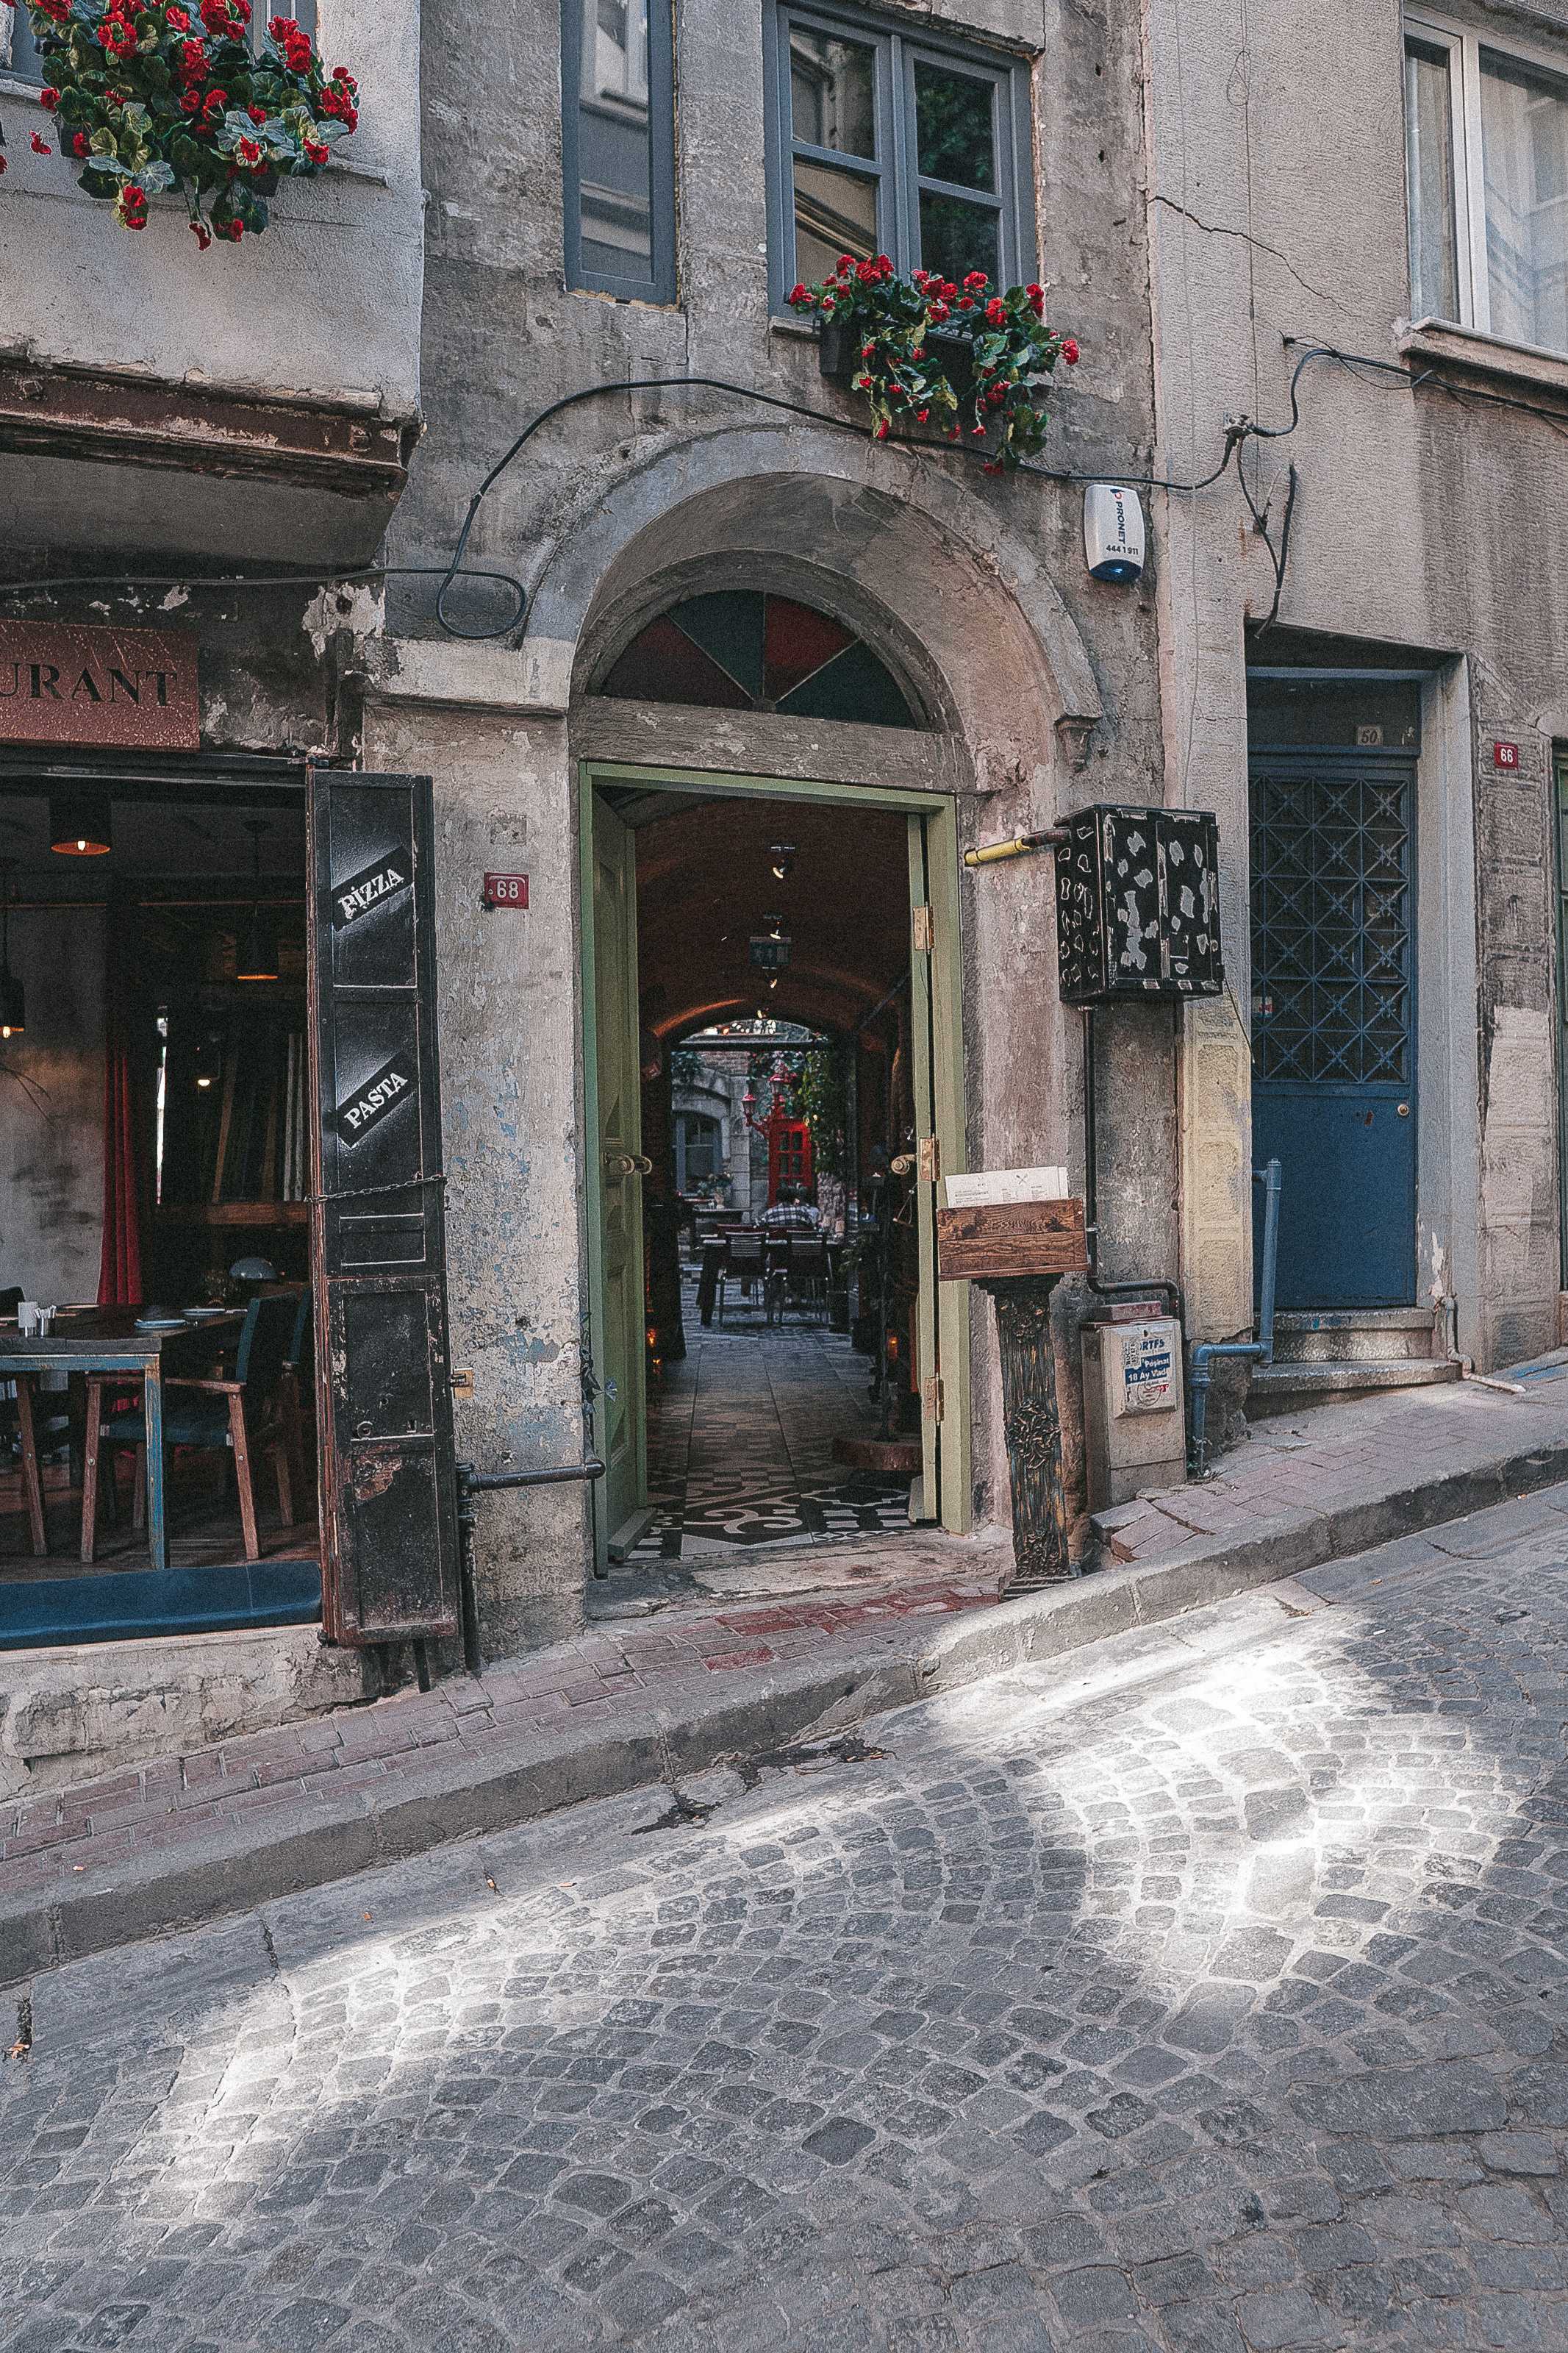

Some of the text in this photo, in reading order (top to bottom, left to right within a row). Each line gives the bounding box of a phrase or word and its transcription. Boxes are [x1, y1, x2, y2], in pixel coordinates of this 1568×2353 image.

[1116, 501, 1125, 544] PRONET
[1106, 545, 1121, 553] 444
[1128, 547, 1139, 555] 911
[1361, 729, 1378, 744] 50
[1500, 748, 1514, 763] 66
[496, 880, 519, 899] 68
[343, 1072, 409, 1129] PASTA
[1128, 1373, 1138, 1382] 18
[1139, 1371, 1150, 1381] Ay
